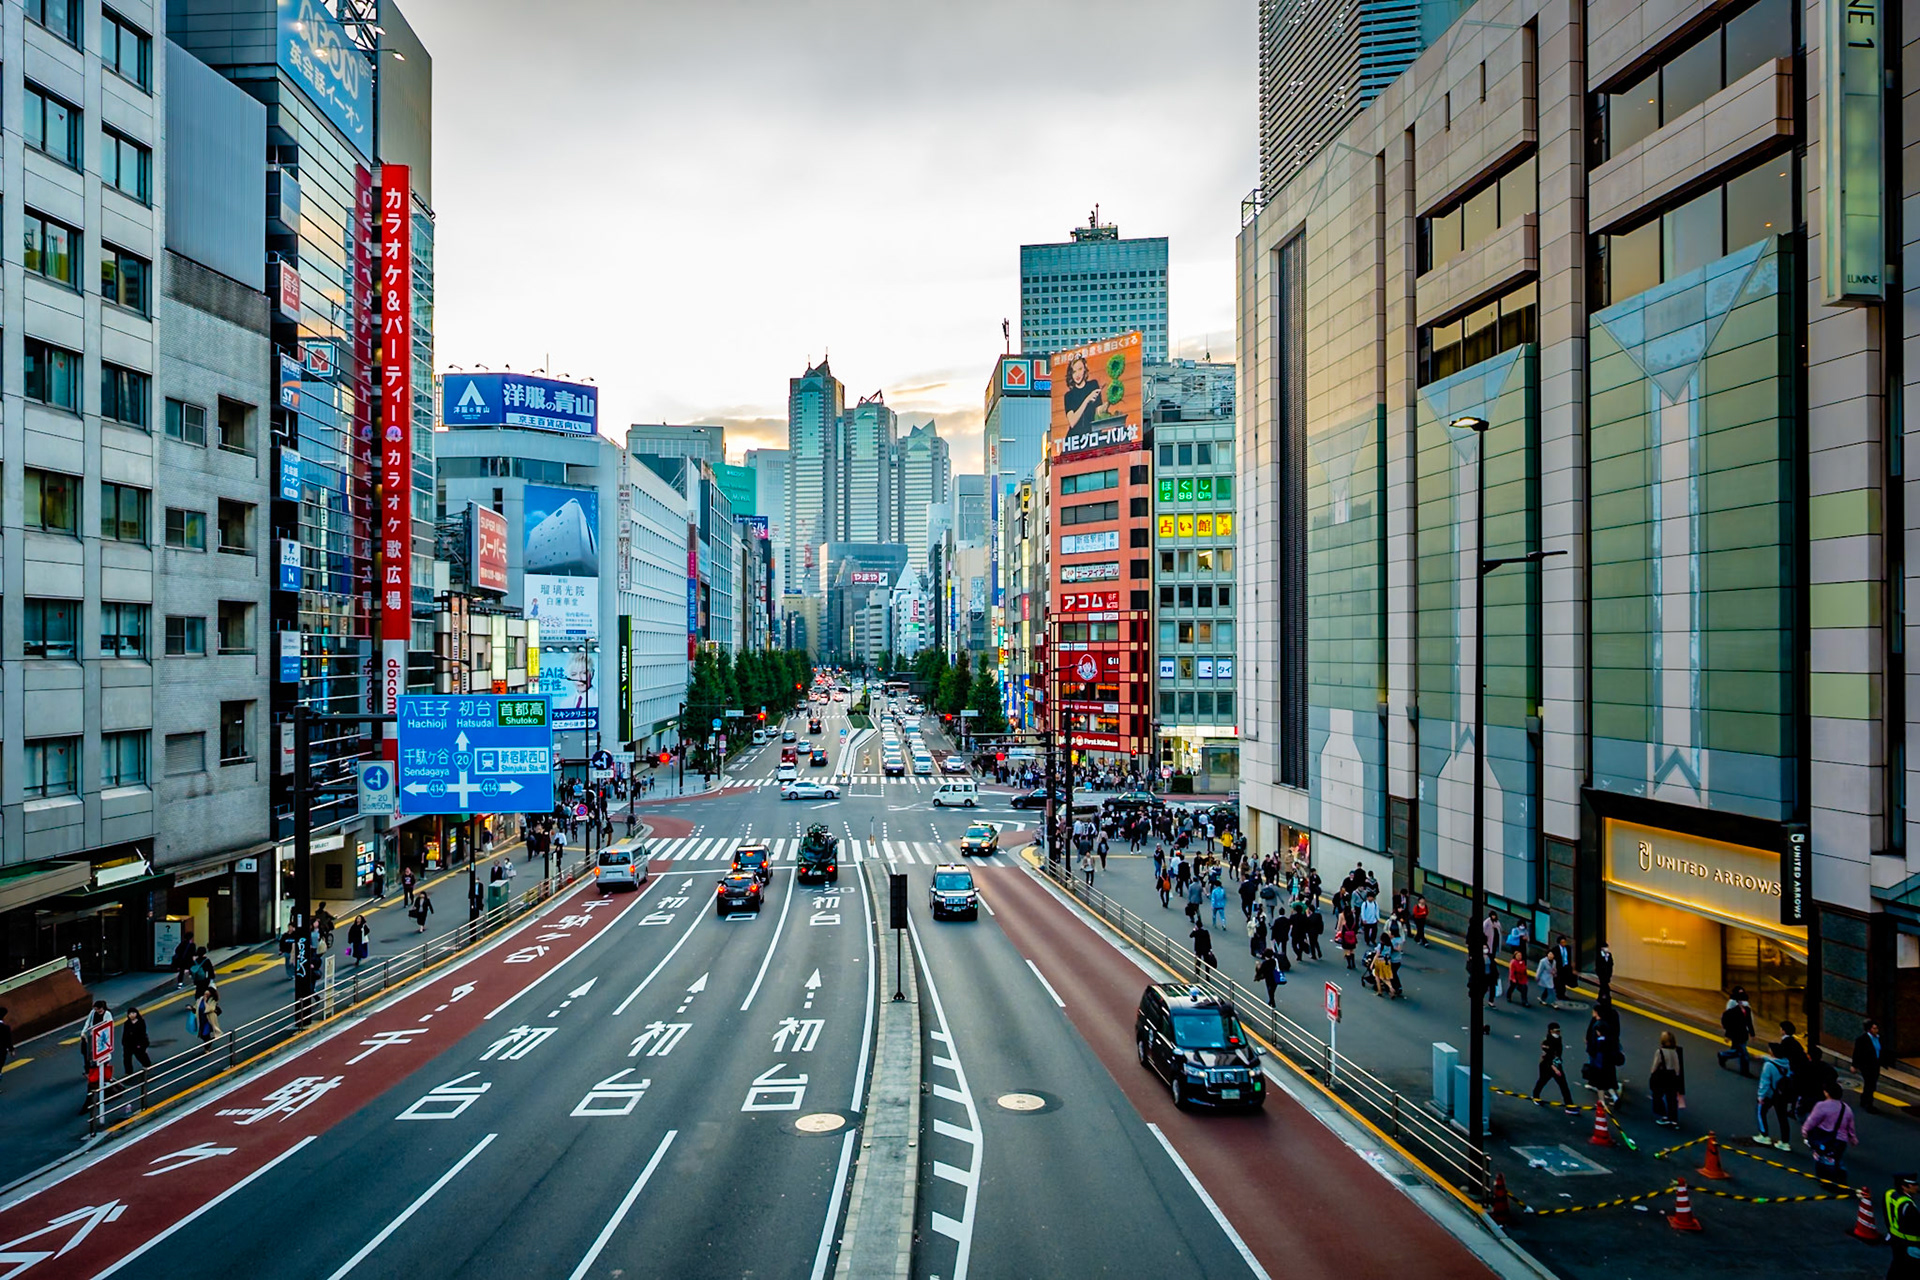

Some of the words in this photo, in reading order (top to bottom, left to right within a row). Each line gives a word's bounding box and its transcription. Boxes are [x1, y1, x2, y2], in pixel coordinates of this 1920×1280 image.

[1848, 38, 1874, 48] 1
[290, 39, 364, 133] 英会話イーオン
[1848, 275, 1878, 284] LUMINE
[385, 187, 403, 421] カラオケ&パーティー
[503, 383, 595, 417] 洋服の青山
[453, 406, 490, 414] 洋服の青山
[518, 415, 583, 430] 京王百貨店向い
[1054, 424, 1139, 454] THEグローバル社
[1161, 480, 1209, 491] ほぐし
[386, 449, 402, 610] カラオケ歌広場
[1160, 519, 1211, 534] 占い館
[853, 573, 878, 581] やまや
[1064, 593, 1104, 610] アコム
[1107, 593, 1117, 601] 6F
[403, 701, 451, 717] 八王子
[459, 701, 492, 717] 初台
[501, 702, 543, 717] 首都高
[407, 719, 447, 730] Hachioji
[456, 718, 494, 728] Hatsudai
[506, 716, 538, 725] Shutoko
[456, 756, 469, 765] 20
[500, 750, 547, 764] 新宿駅西口
[404, 768, 449, 777] Sendagaya
[501, 764, 526, 773] Shinjuku
[430, 784, 444, 792] 414
[482, 784, 497, 792] 414
[1793, 845, 1802, 878] UNITED
[1656, 854, 1709, 879] UNITED
[1713, 868, 1781, 897] ARROWS
[1793, 882, 1802, 919] ARROWS
[638, 896, 690, 926] 初台
[809, 896, 841, 926] 初台
[394, 1025, 558, 1120] 初台
[570, 1021, 694, 1117] 初台
[741, 1017, 826, 1112] 初台
